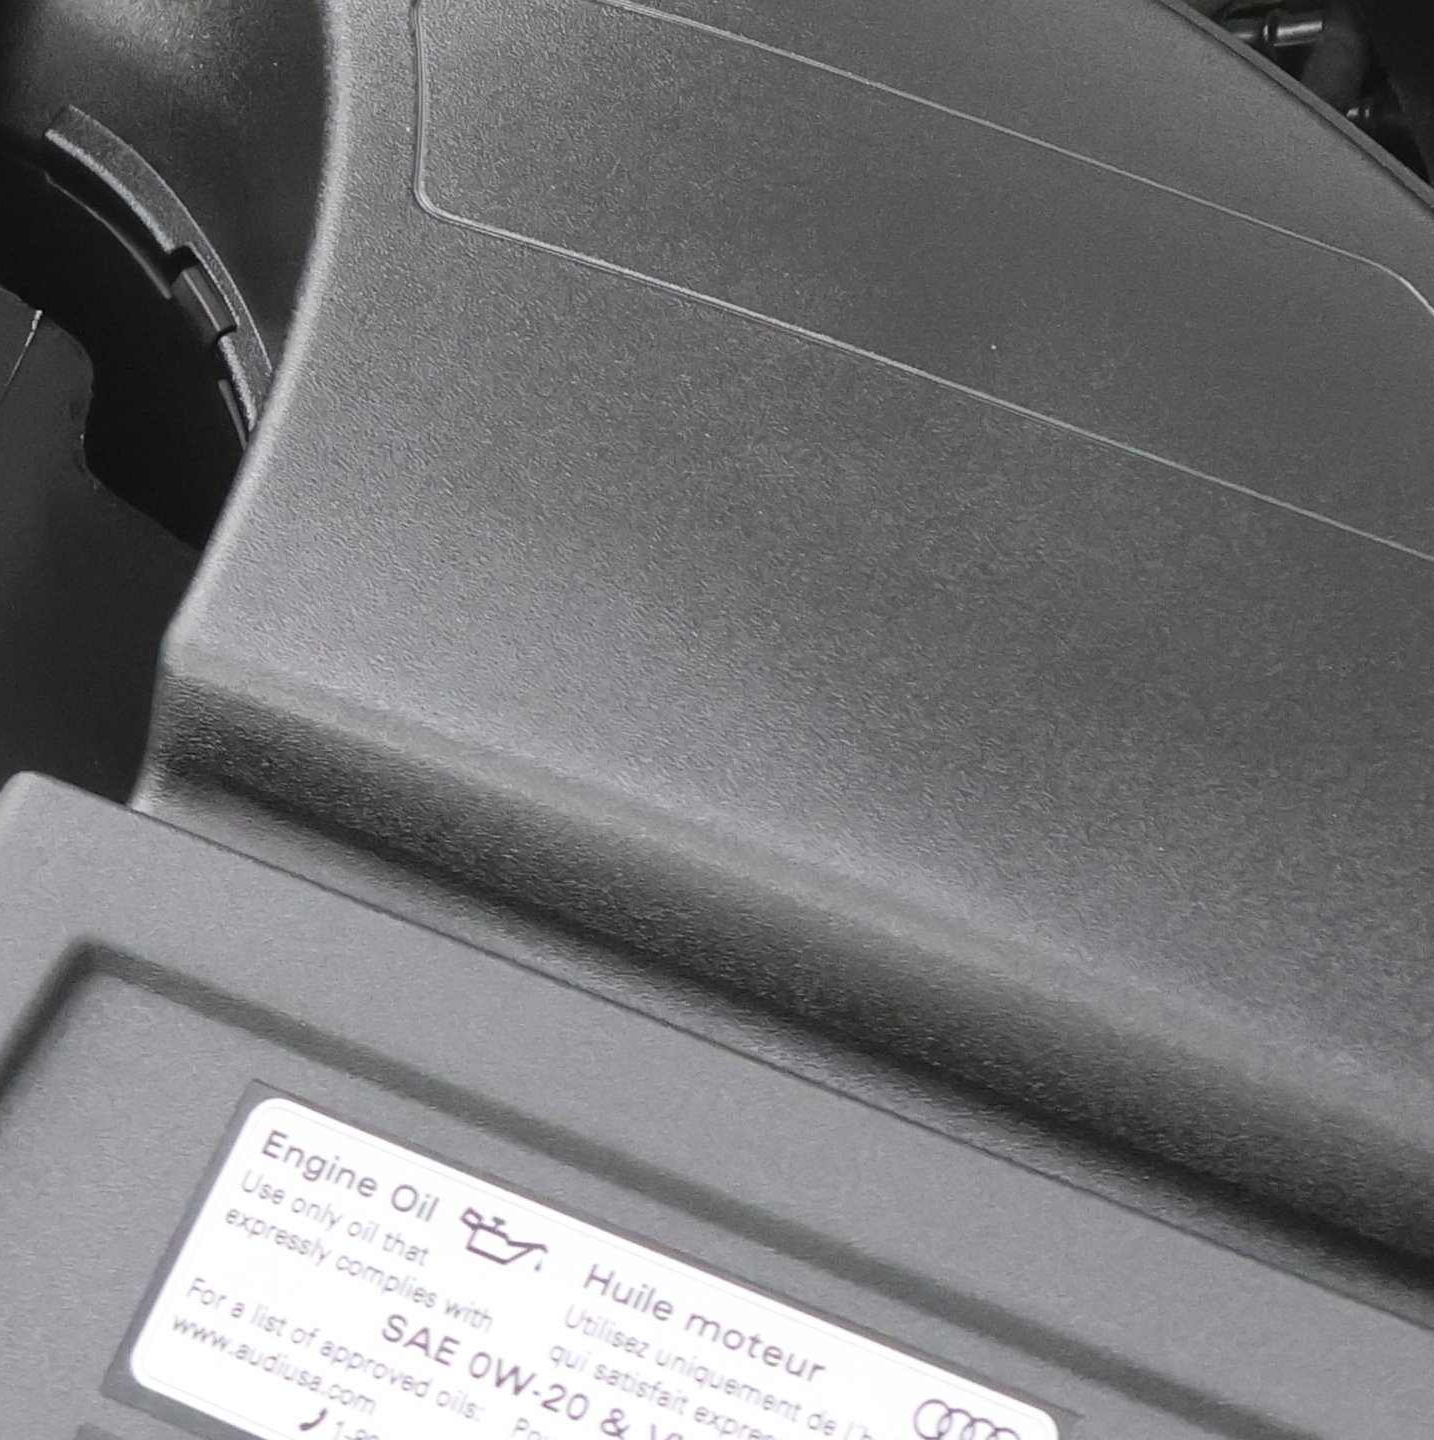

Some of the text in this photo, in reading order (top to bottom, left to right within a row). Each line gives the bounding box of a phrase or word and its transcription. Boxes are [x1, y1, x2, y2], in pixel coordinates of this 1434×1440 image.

[240, 1170, 431, 1267] Use only oil that
[261, 1129, 441, 1223] Engine Oil
[224, 1207, 494, 1333] expressly complies with
[583, 1263, 827, 1383] Huile moteur
[171, 1314, 377, 1416] www.audiusa.com
[186, 1277, 486, 1422] For a list of approved oils:
[381, 1313, 631, 1440] SAE 0W-20 &
[548, 1343, 590, 1373] qui
[593, 1358, 690, 1417] satisfait
[564, 1304, 650, 1360] Utilisez
[655, 1344, 802, 1422] uniquement
[806, 1408, 837, 1437] de
